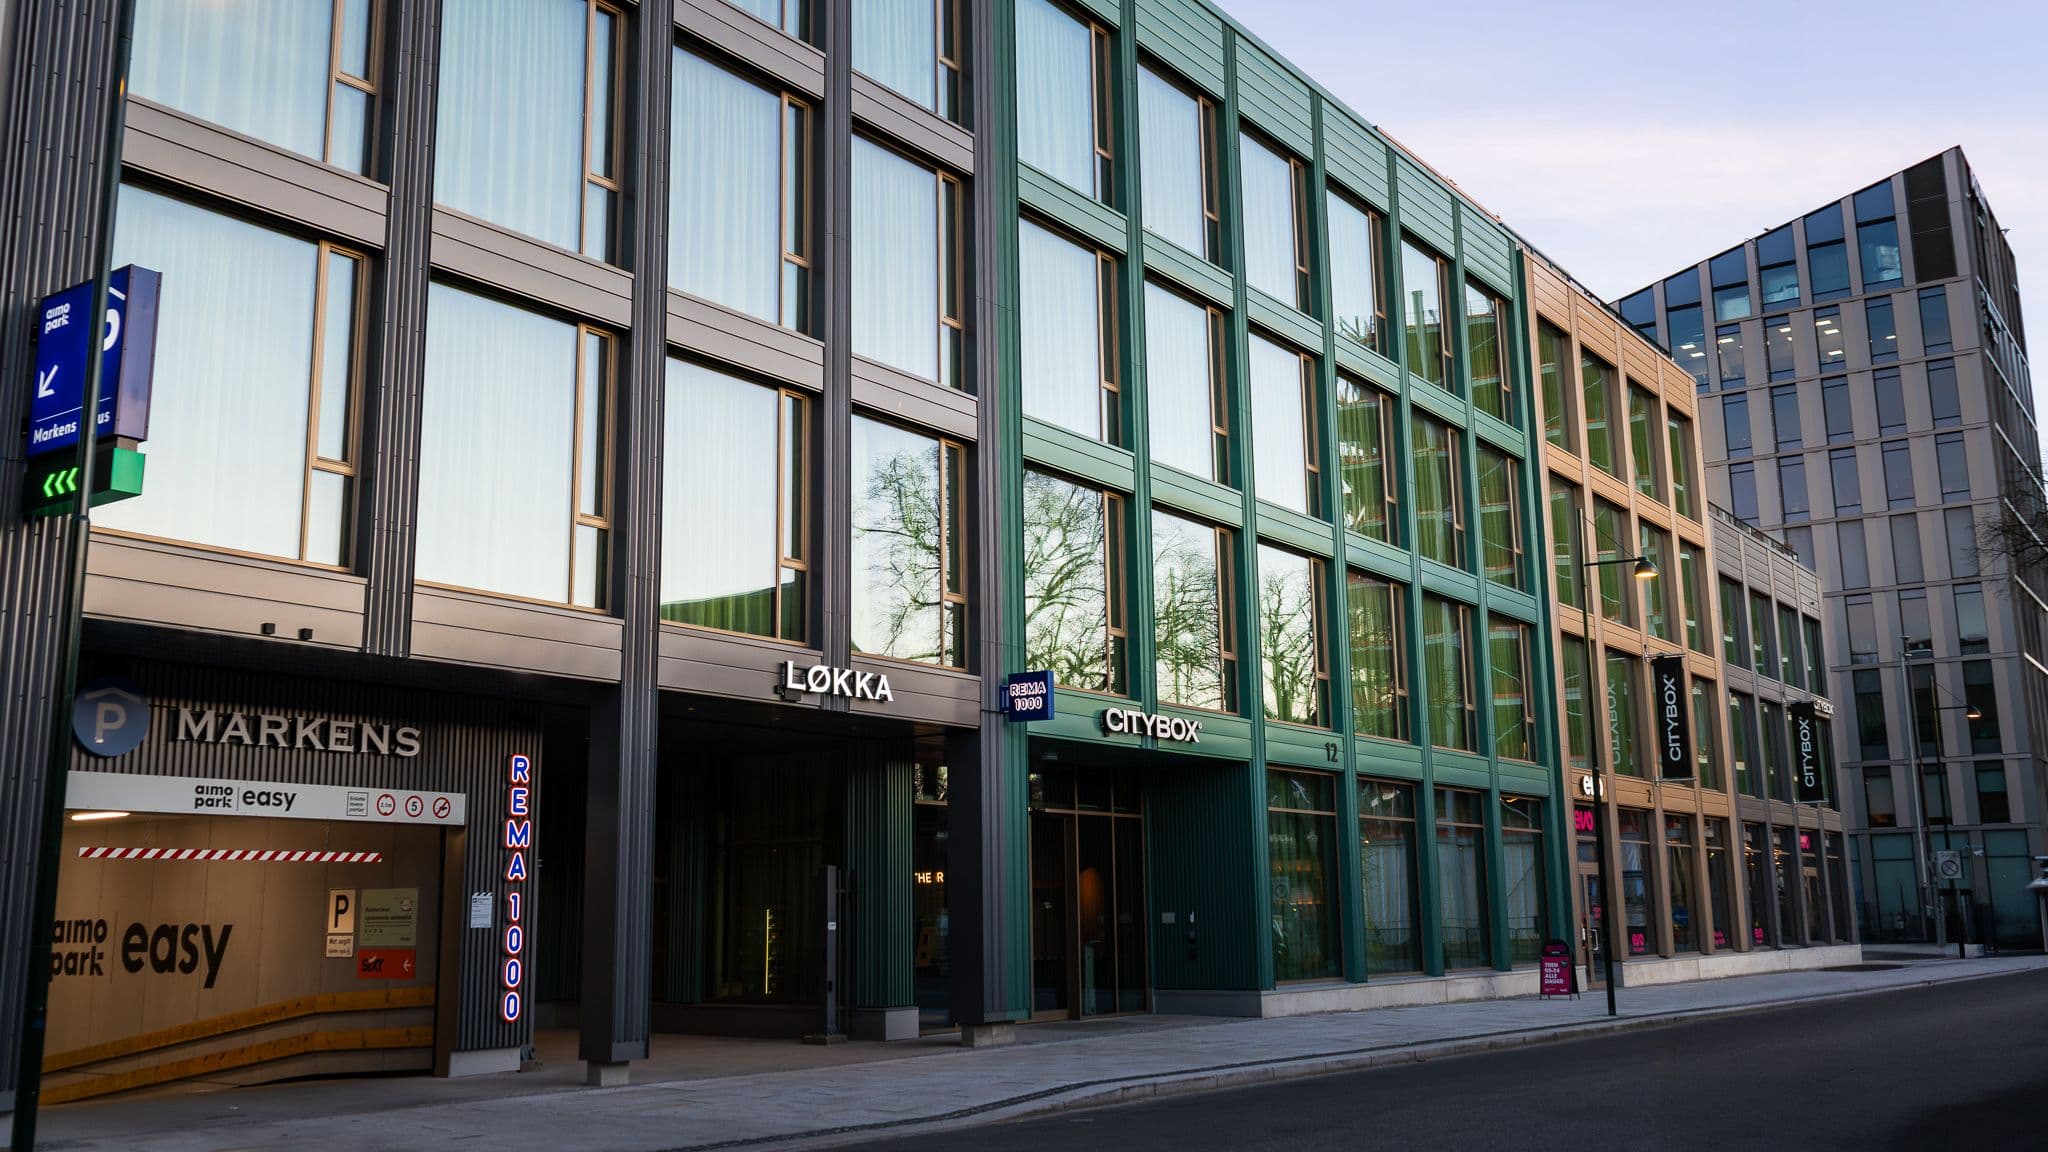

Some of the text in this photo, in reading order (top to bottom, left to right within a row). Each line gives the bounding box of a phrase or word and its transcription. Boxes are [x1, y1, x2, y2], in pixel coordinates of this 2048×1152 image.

[46, 302, 70, 319] aimo
[44, 316, 70, 334] park
[33, 421, 78, 444] Markens
[785, 660, 894, 702] LØKKA
[1010, 681, 1046, 697] REMA
[1014, 696, 1043, 711] 1000
[1106, 707, 1201, 744] CITYBOX
[1664, 677, 1682, 762] CITYBOX
[177, 707, 421, 758] MARKENS
[1325, 742, 1339, 763] 12
[1799, 718, 1815, 787] CITYBOX
[195, 785, 234, 796] aimo
[242, 790, 297, 812] easy
[194, 796, 233, 809] park
[411, 801, 418, 812] 5
[1574, 810, 1594, 832] evo
[503, 754, 531, 1022] REMA 1000
[915, 872, 931, 884] HE
[334, 895, 349, 928] P
[53, 919, 108, 944] aimo
[50, 946, 104, 983] park
[122, 922, 233, 989] easy
